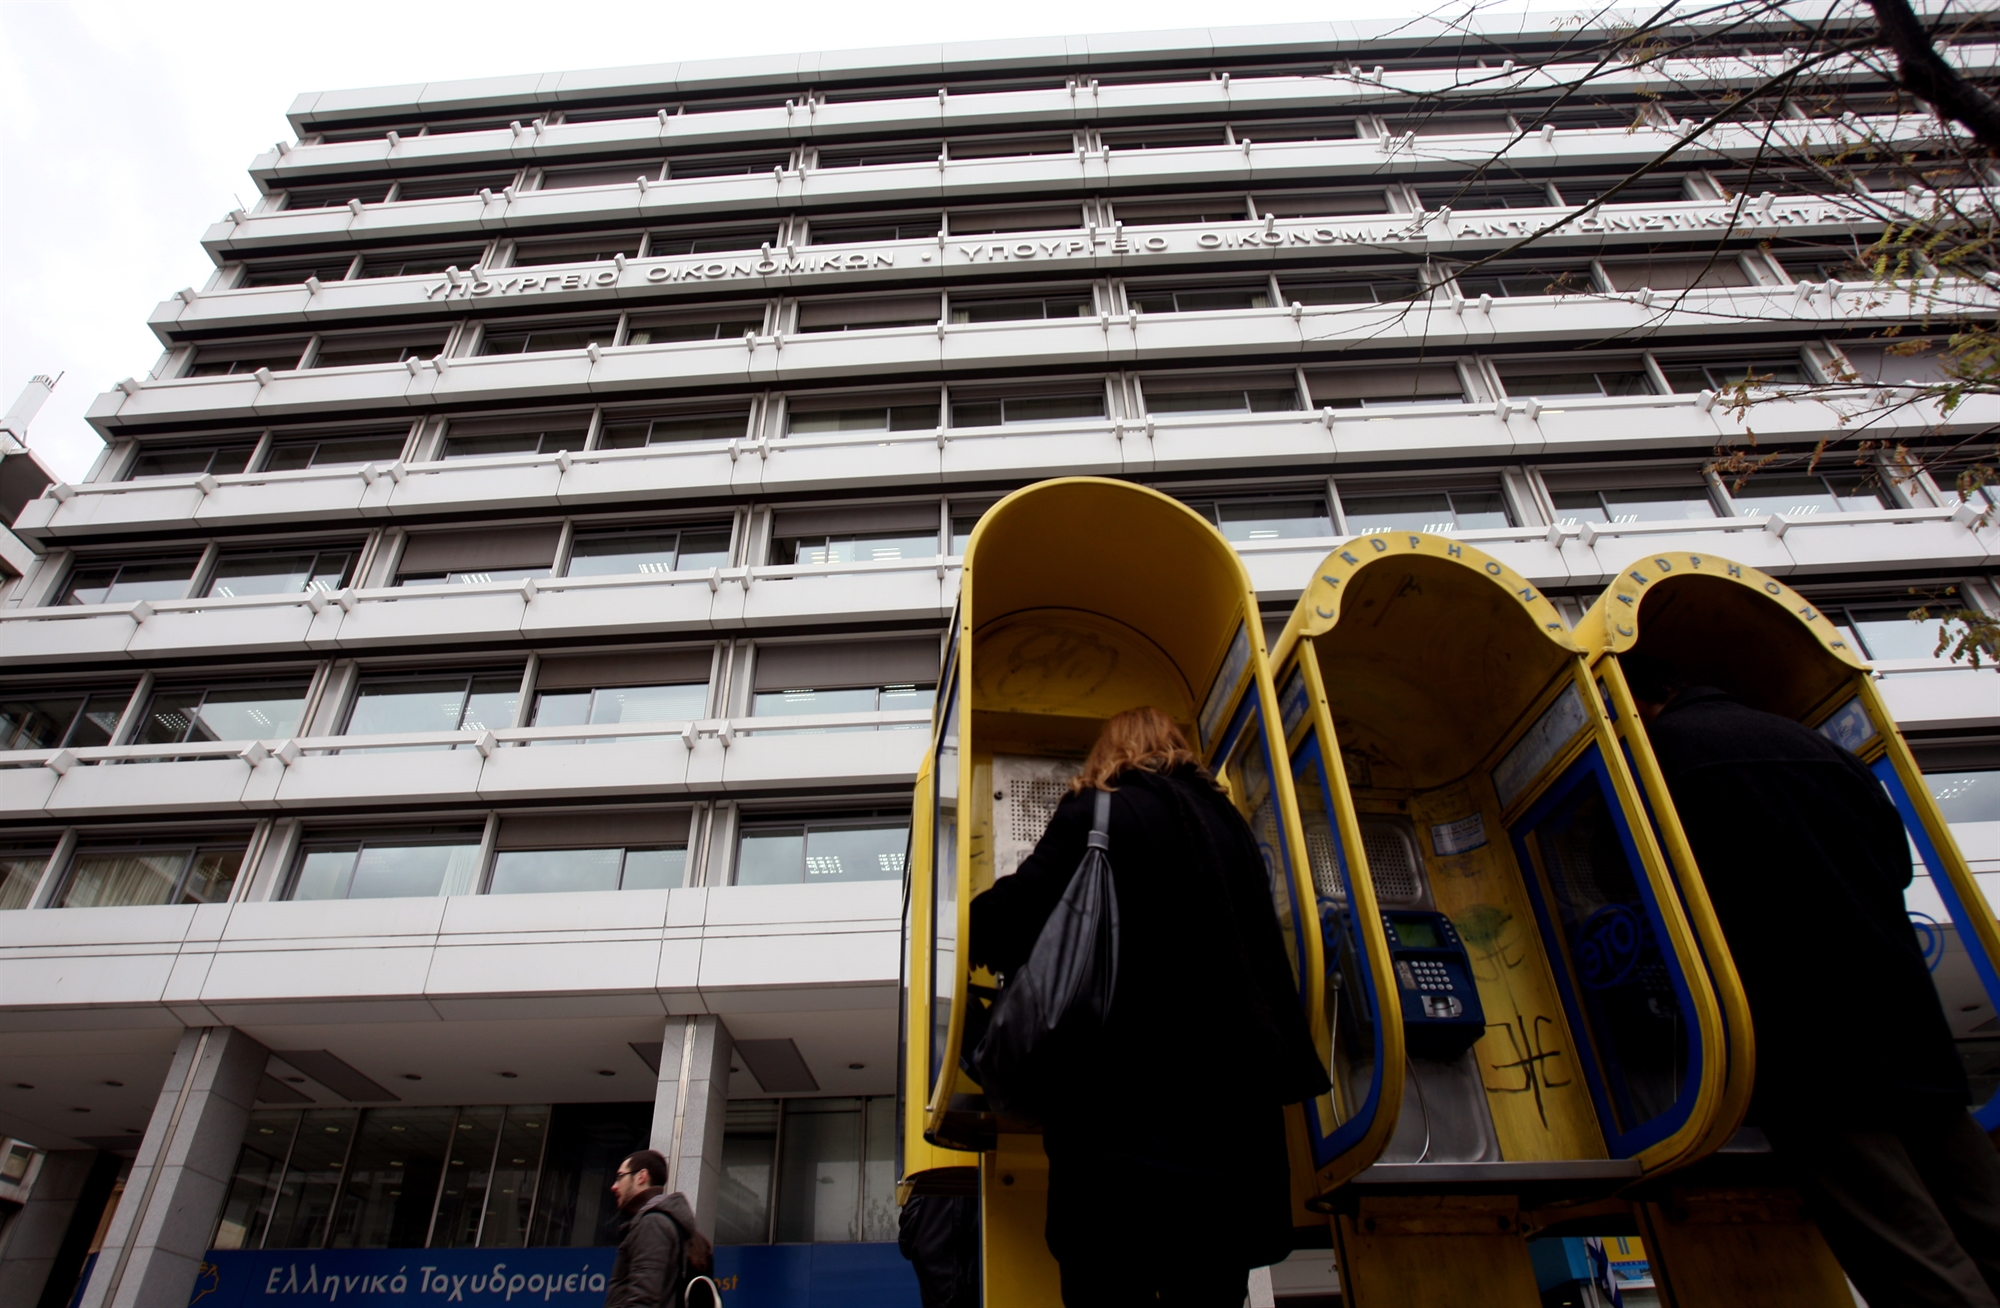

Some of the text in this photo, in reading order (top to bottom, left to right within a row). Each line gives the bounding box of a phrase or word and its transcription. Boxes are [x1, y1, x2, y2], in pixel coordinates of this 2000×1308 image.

[424, 269, 618, 299] ΥΠΟΥΡΓΕΙΟ
[645, 251, 895, 283] ΟΙΚΟΝΟΜΙΚΩΝ
[959, 236, 1169, 261] ΥΠΟΥΡΓΕΙΟ
[1316, 536, 1563, 632] CARDPHONE
[1617, 555, 1847, 650] CARDPHONE
[265, 1265, 606, 1301] Ελληνικά Ταχυδρομεία
